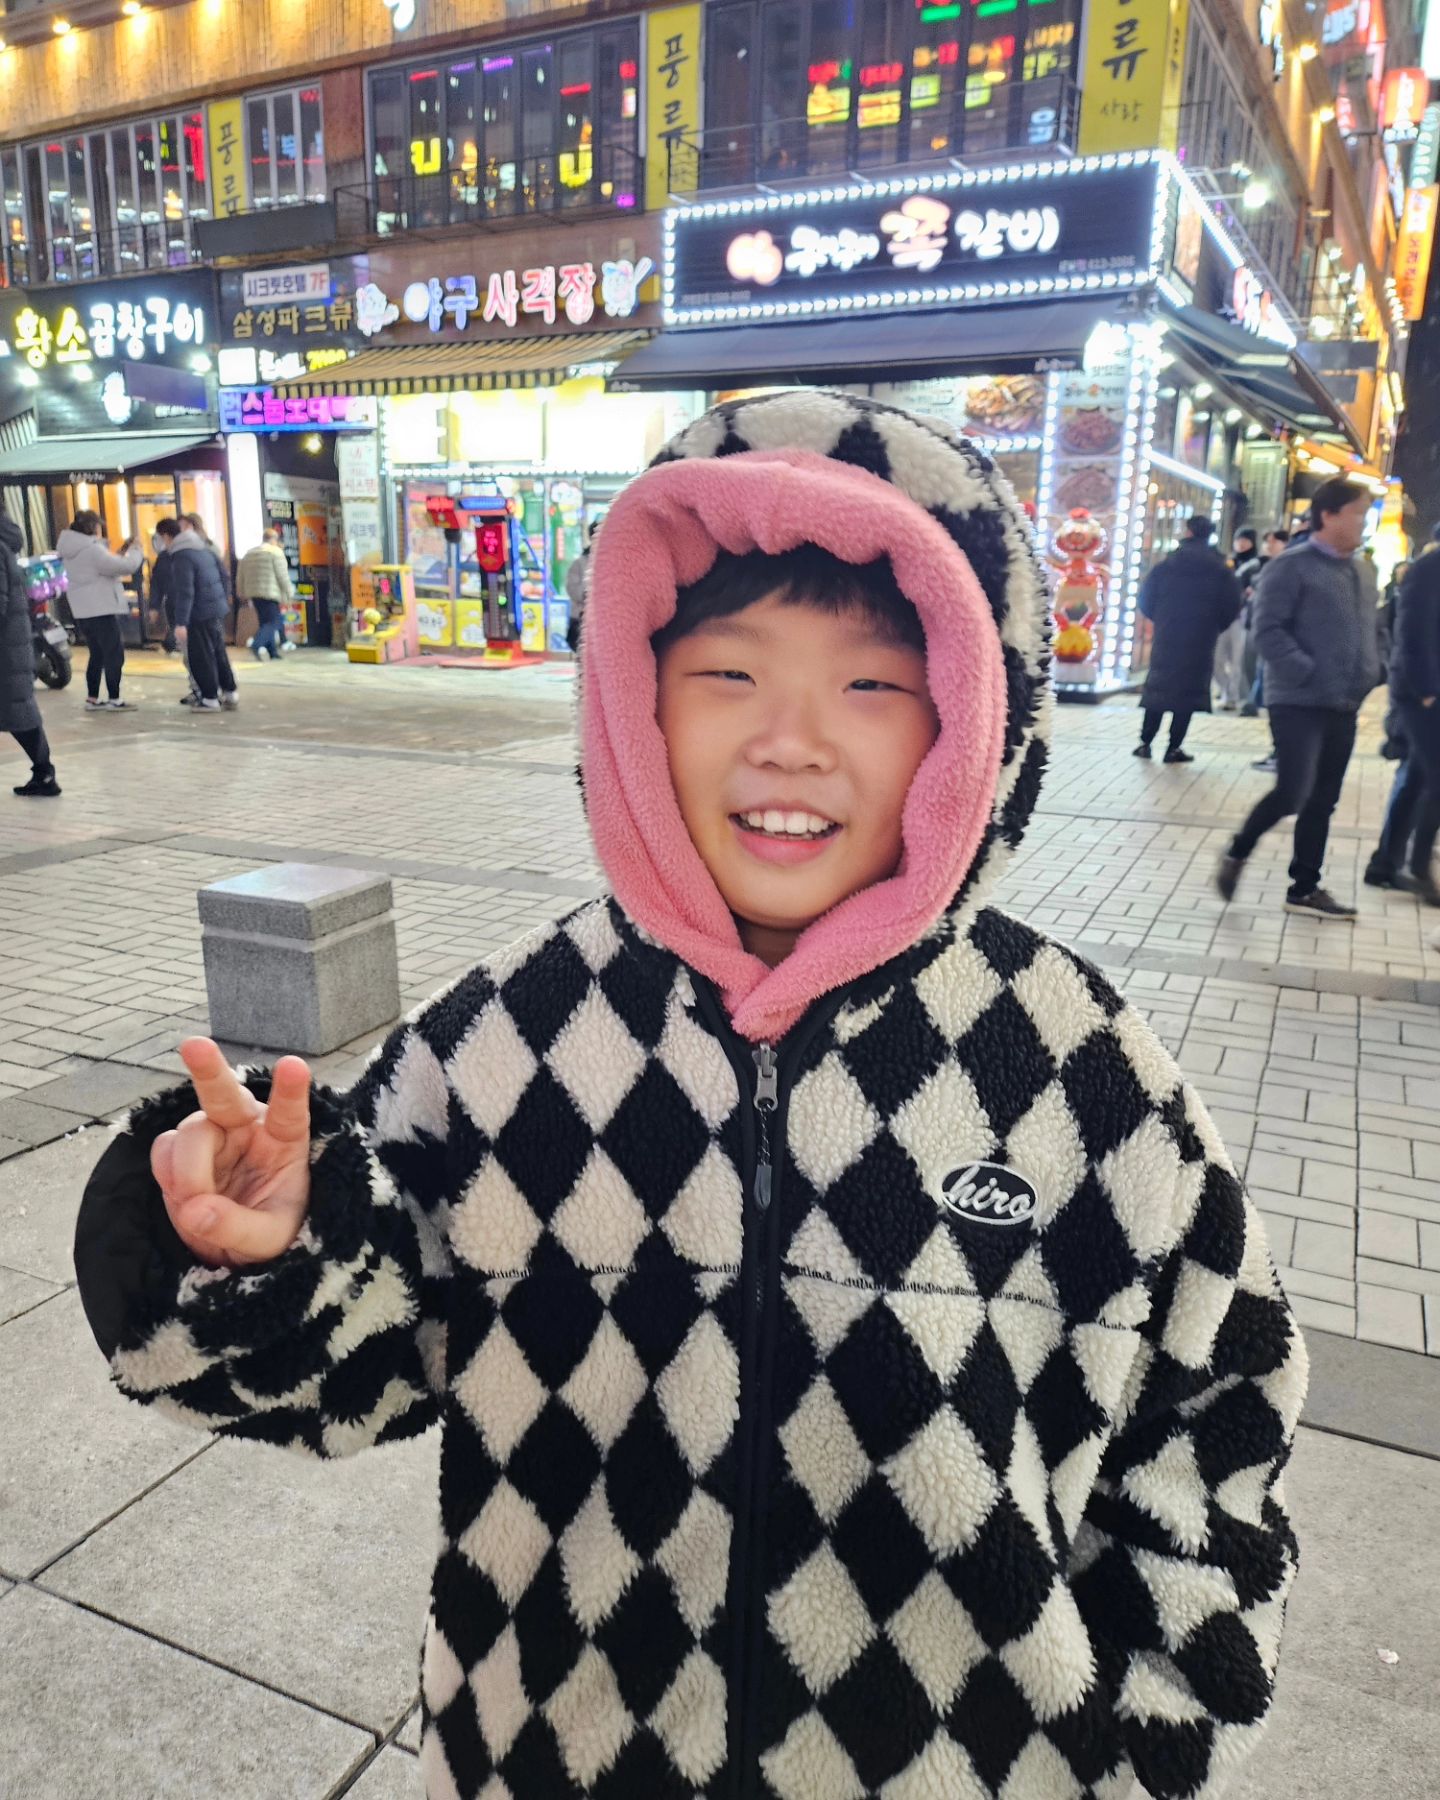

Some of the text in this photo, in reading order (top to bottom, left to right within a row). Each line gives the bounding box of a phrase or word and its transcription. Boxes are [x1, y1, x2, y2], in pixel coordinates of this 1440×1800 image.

[658, 34, 690, 150] 풍류
[310, 272, 328, 291] 7F
[404, 262, 597, 332] 야구 사격장
[944, 1165, 1032, 1217] hiro
